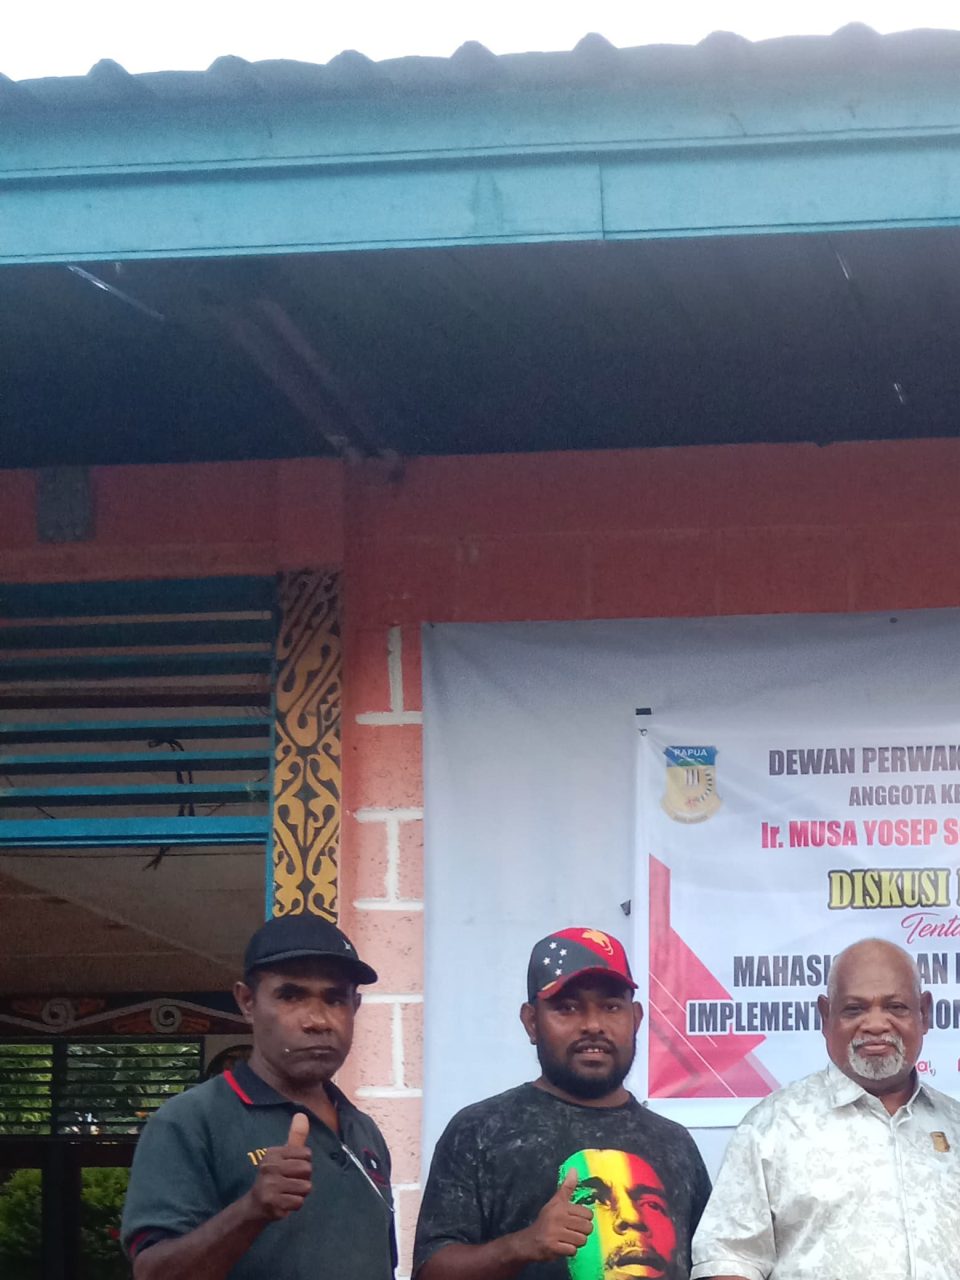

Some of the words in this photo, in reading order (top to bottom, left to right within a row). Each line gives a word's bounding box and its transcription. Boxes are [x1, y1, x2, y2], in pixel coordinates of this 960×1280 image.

[768, 748, 856, 776] DEWAN
[848, 784, 936, 807] ANGGOTA
[760, 822, 784, 848] Ir.
[789, 820, 859, 847] MUSA
[864, 818, 938, 846] YOSEP
[828, 868, 950, 909] DISKUSI
[733, 954, 839, 987] MAHASI
[915, 952, 948, 985] AN
[688, 1000, 823, 1032] IMPLEMENT
